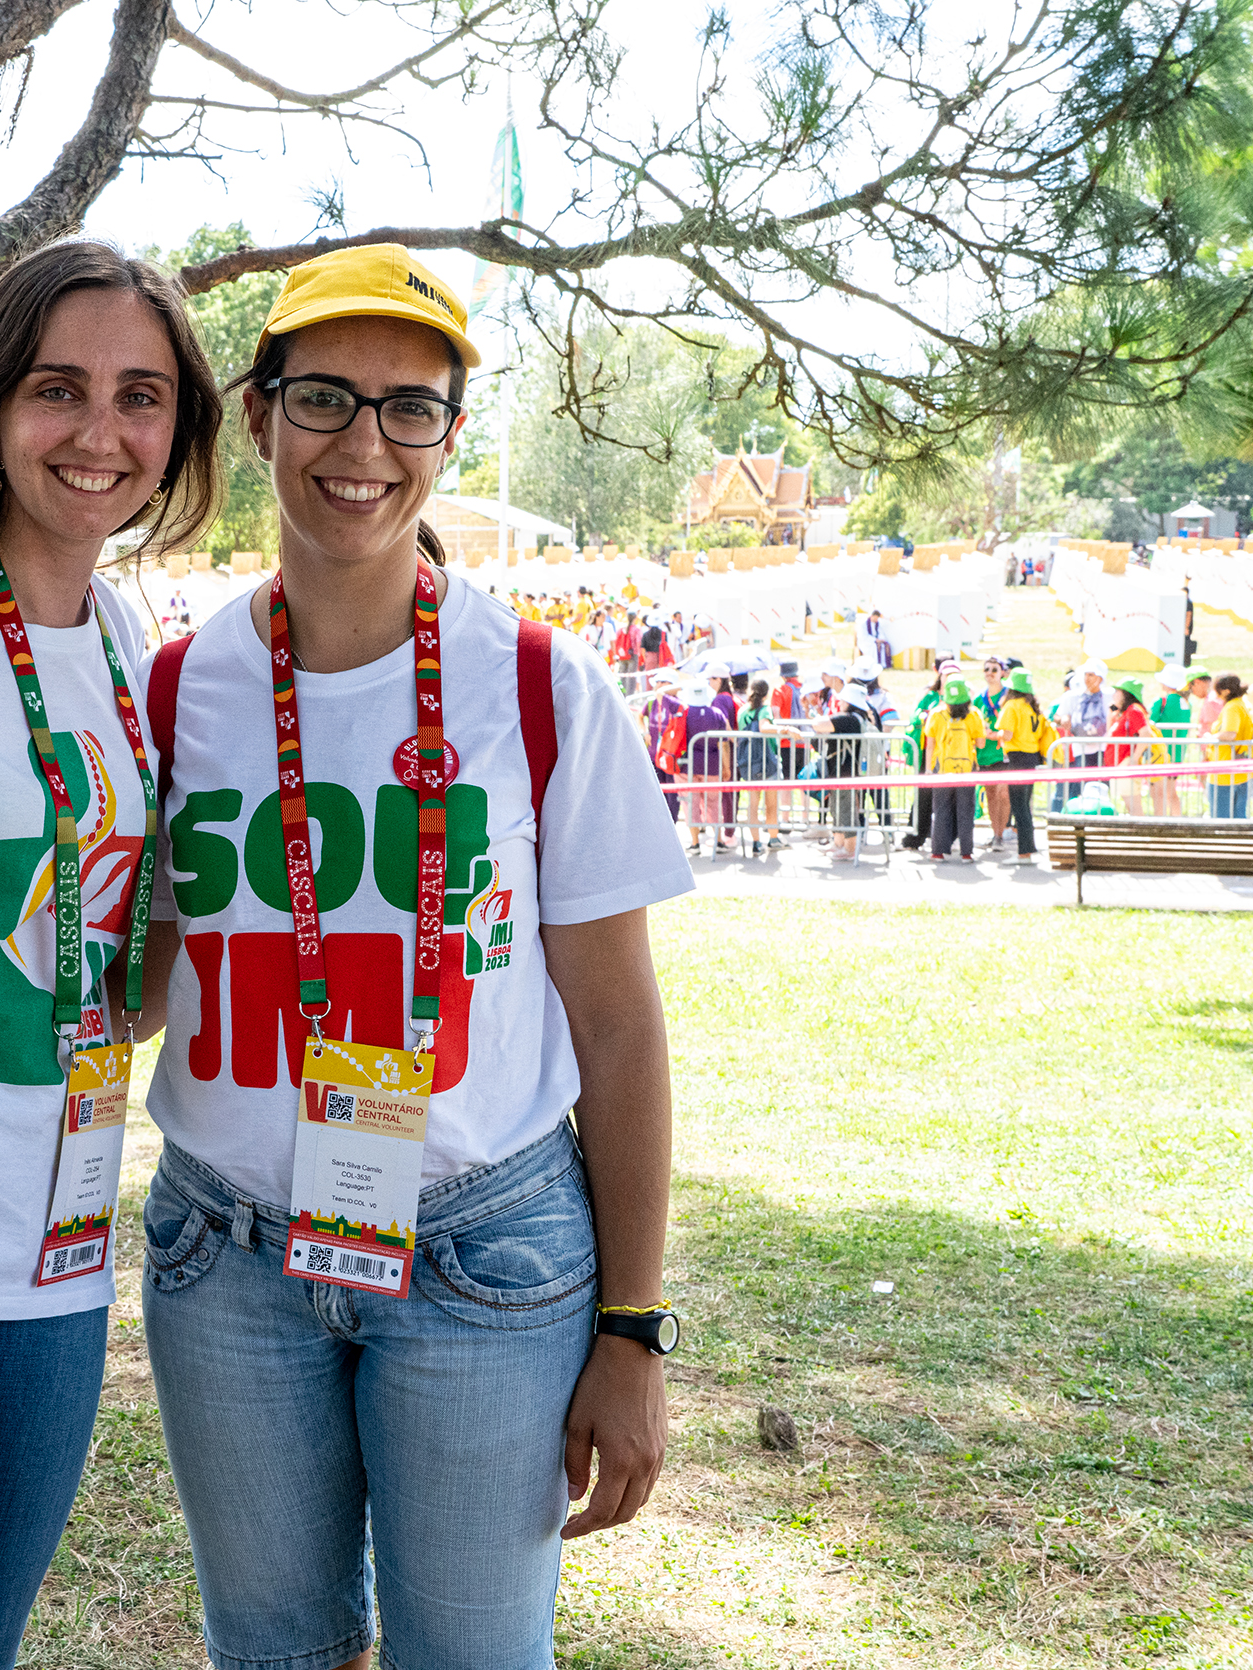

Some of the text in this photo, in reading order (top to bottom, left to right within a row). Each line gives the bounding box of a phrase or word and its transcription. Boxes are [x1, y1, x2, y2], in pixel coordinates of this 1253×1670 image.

[287, 839, 318, 956] CASCAIS
[129, 852, 154, 964] CASCAIS
[419, 850, 443, 970] CASCAIS
[59, 861, 79, 977] CASCAIS
[488, 920, 513, 948] JMJ
[486, 944, 511, 957] LISBOA
[485, 953, 510, 971] 2023
[94, 1092, 127, 1106] VOLUNTÁRIO
[358, 1098, 424, 1116] VOLUNTÁRIO
[93, 1105, 115, 1117] CENTRAL
[356, 1109, 402, 1124] CENTRAL
[355, 1120, 415, 1134] CENTRAL VOLUNTEER
[331, 1158, 383, 1174] Sara Silva Camilo
[341, 1170, 372, 1182] COL-3530
[332, 1194, 346, 1203] Team
